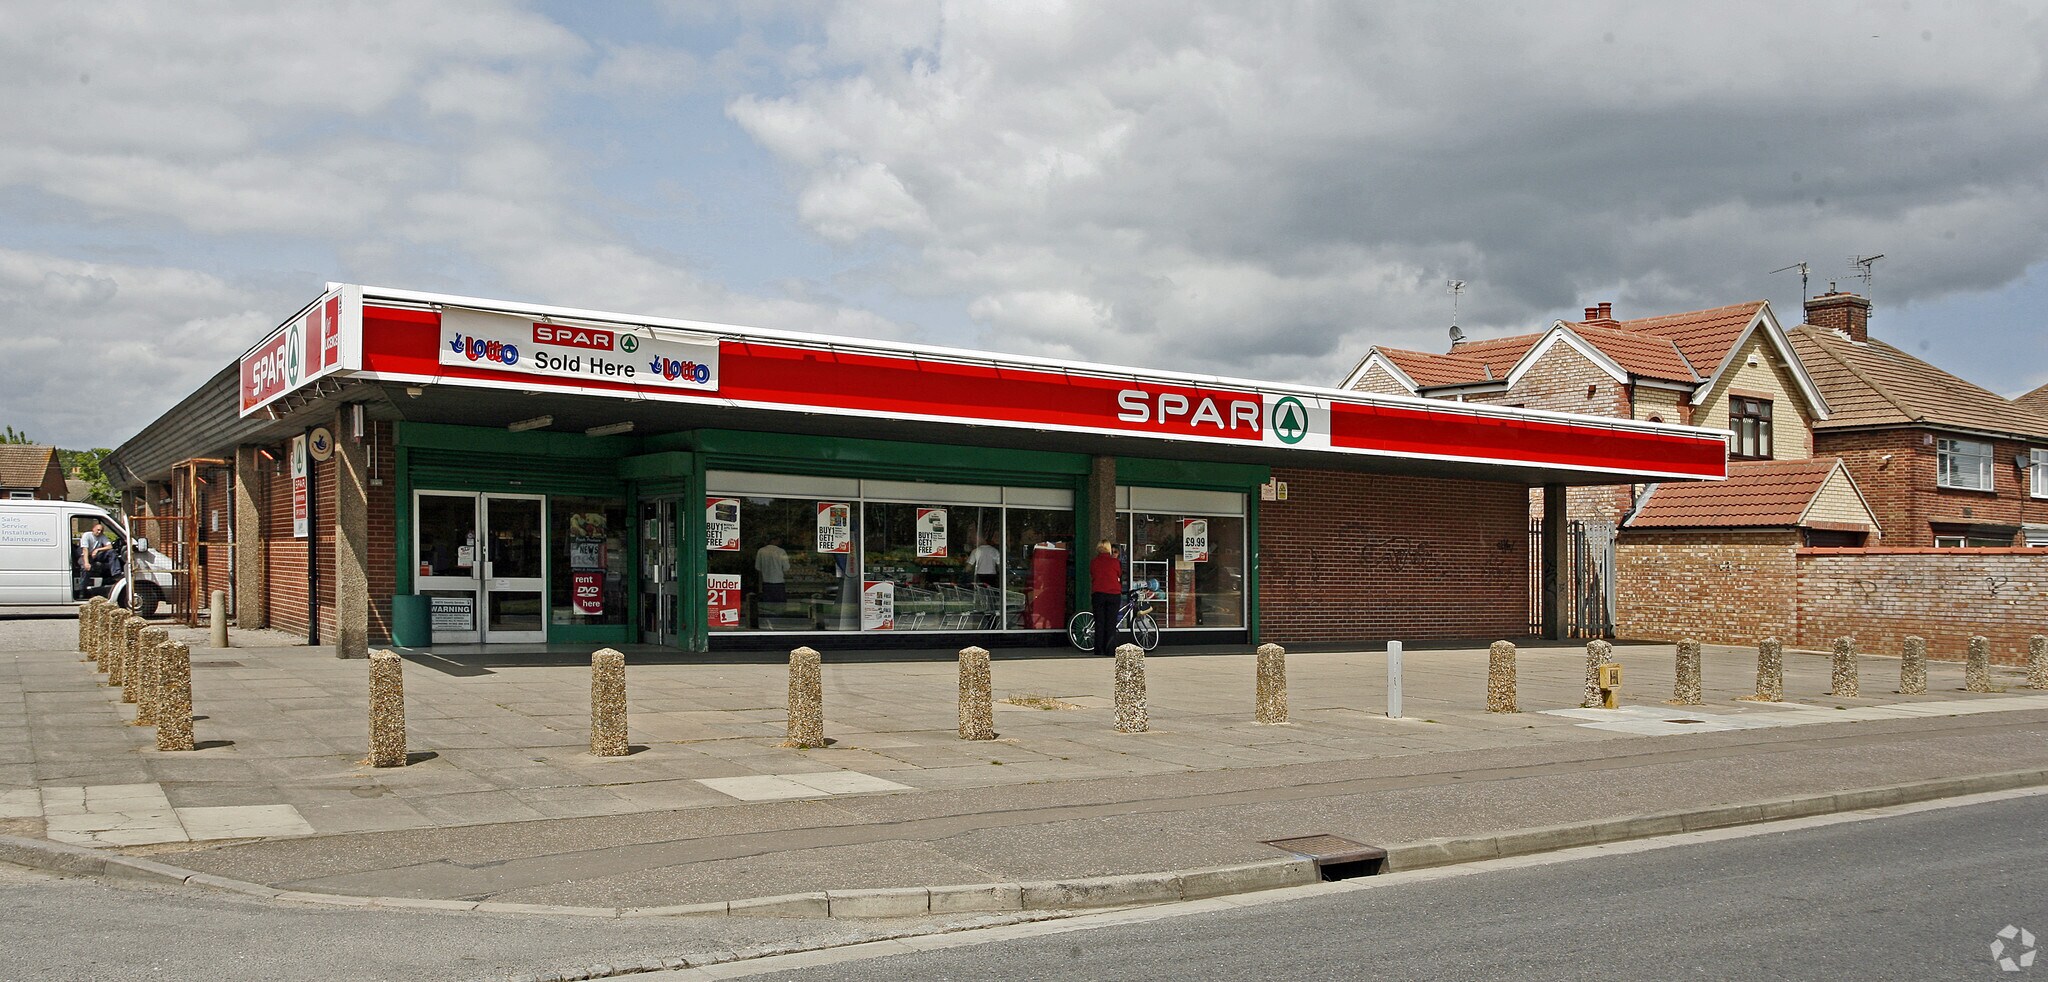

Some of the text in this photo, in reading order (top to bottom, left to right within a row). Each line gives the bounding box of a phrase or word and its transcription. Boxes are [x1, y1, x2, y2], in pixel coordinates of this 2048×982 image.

[537, 327, 609, 347] SPAR
[253, 345, 285, 396] SPAR
[535, 352, 636, 377] Sold Here
[1118, 389, 1260, 432] SPAR
[1185, 537, 1206, 547] £9.99
[708, 579, 739, 589] Under
[708, 590, 727, 605] 21
